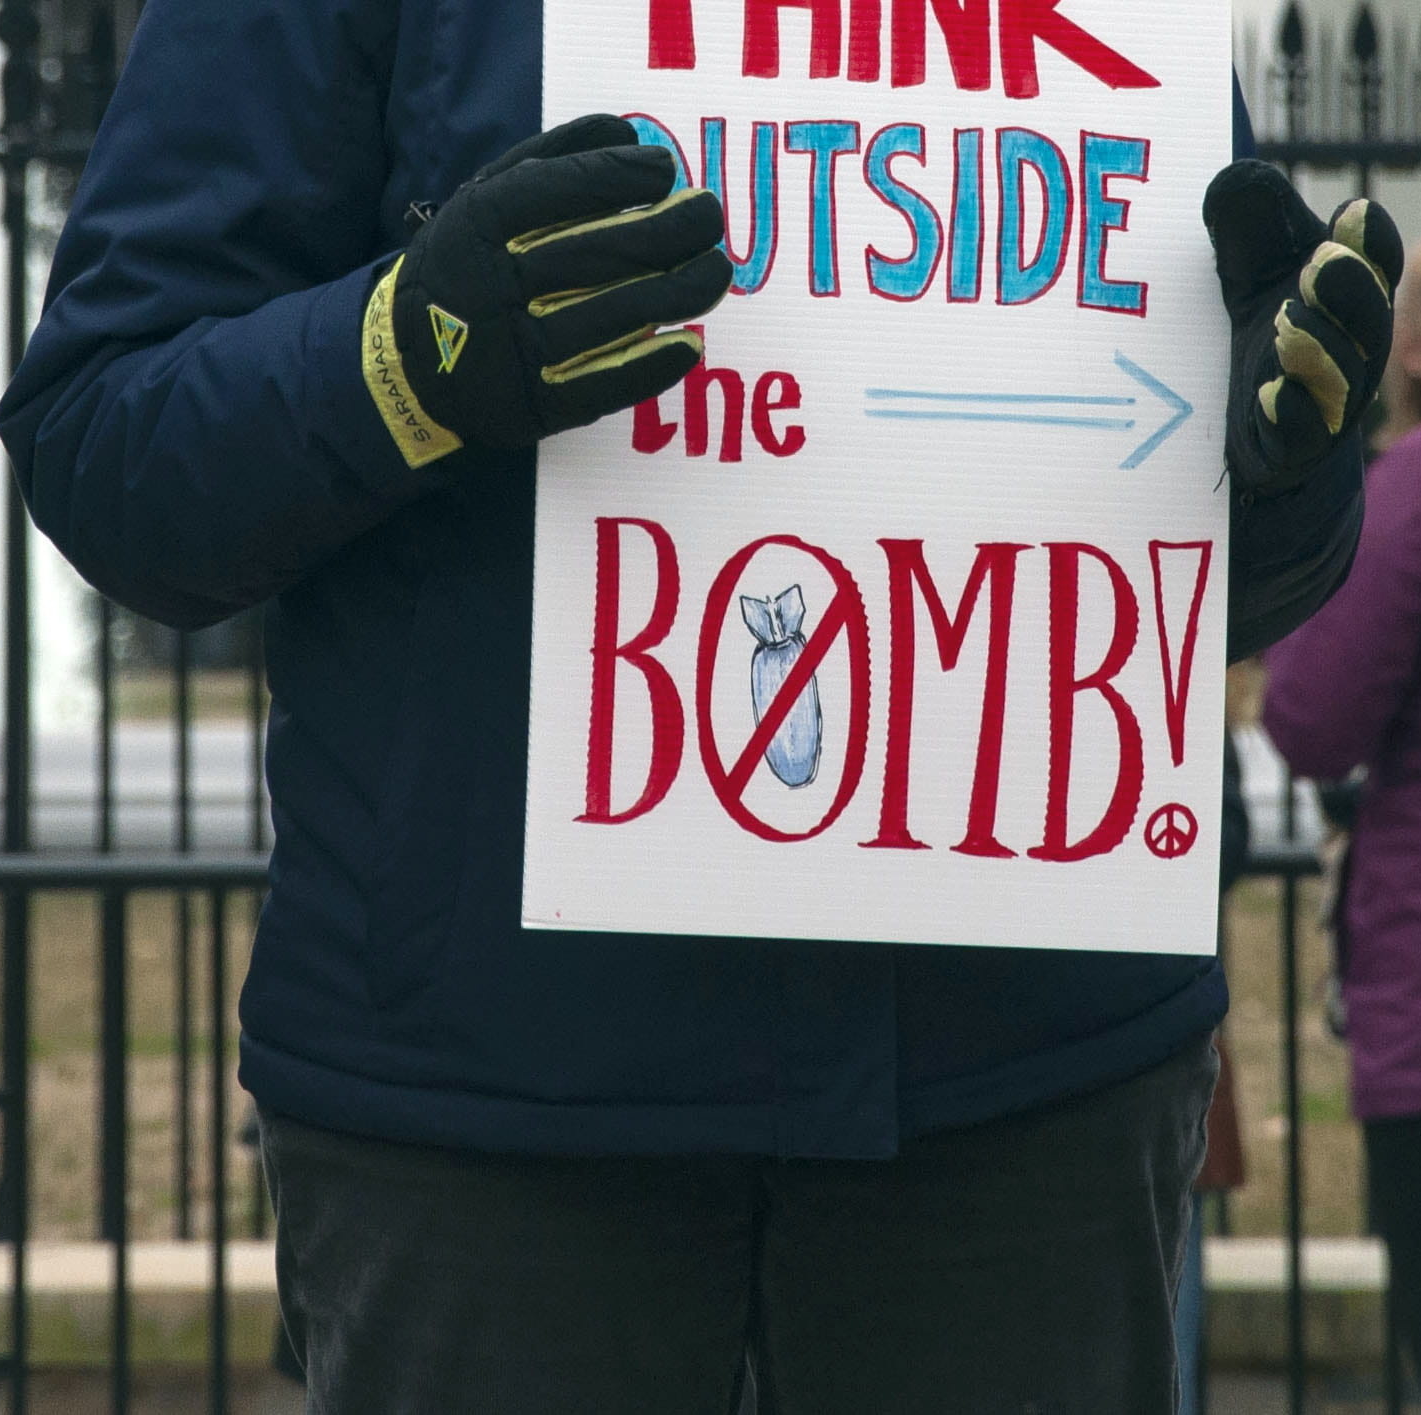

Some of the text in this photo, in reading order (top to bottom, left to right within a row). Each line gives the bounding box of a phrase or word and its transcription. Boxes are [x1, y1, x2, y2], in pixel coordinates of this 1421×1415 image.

[622, 112, 1151, 318] UTSIDE
[372, 334, 431, 443] SARANAC
[572, 516, 1213, 863] BOMB!
